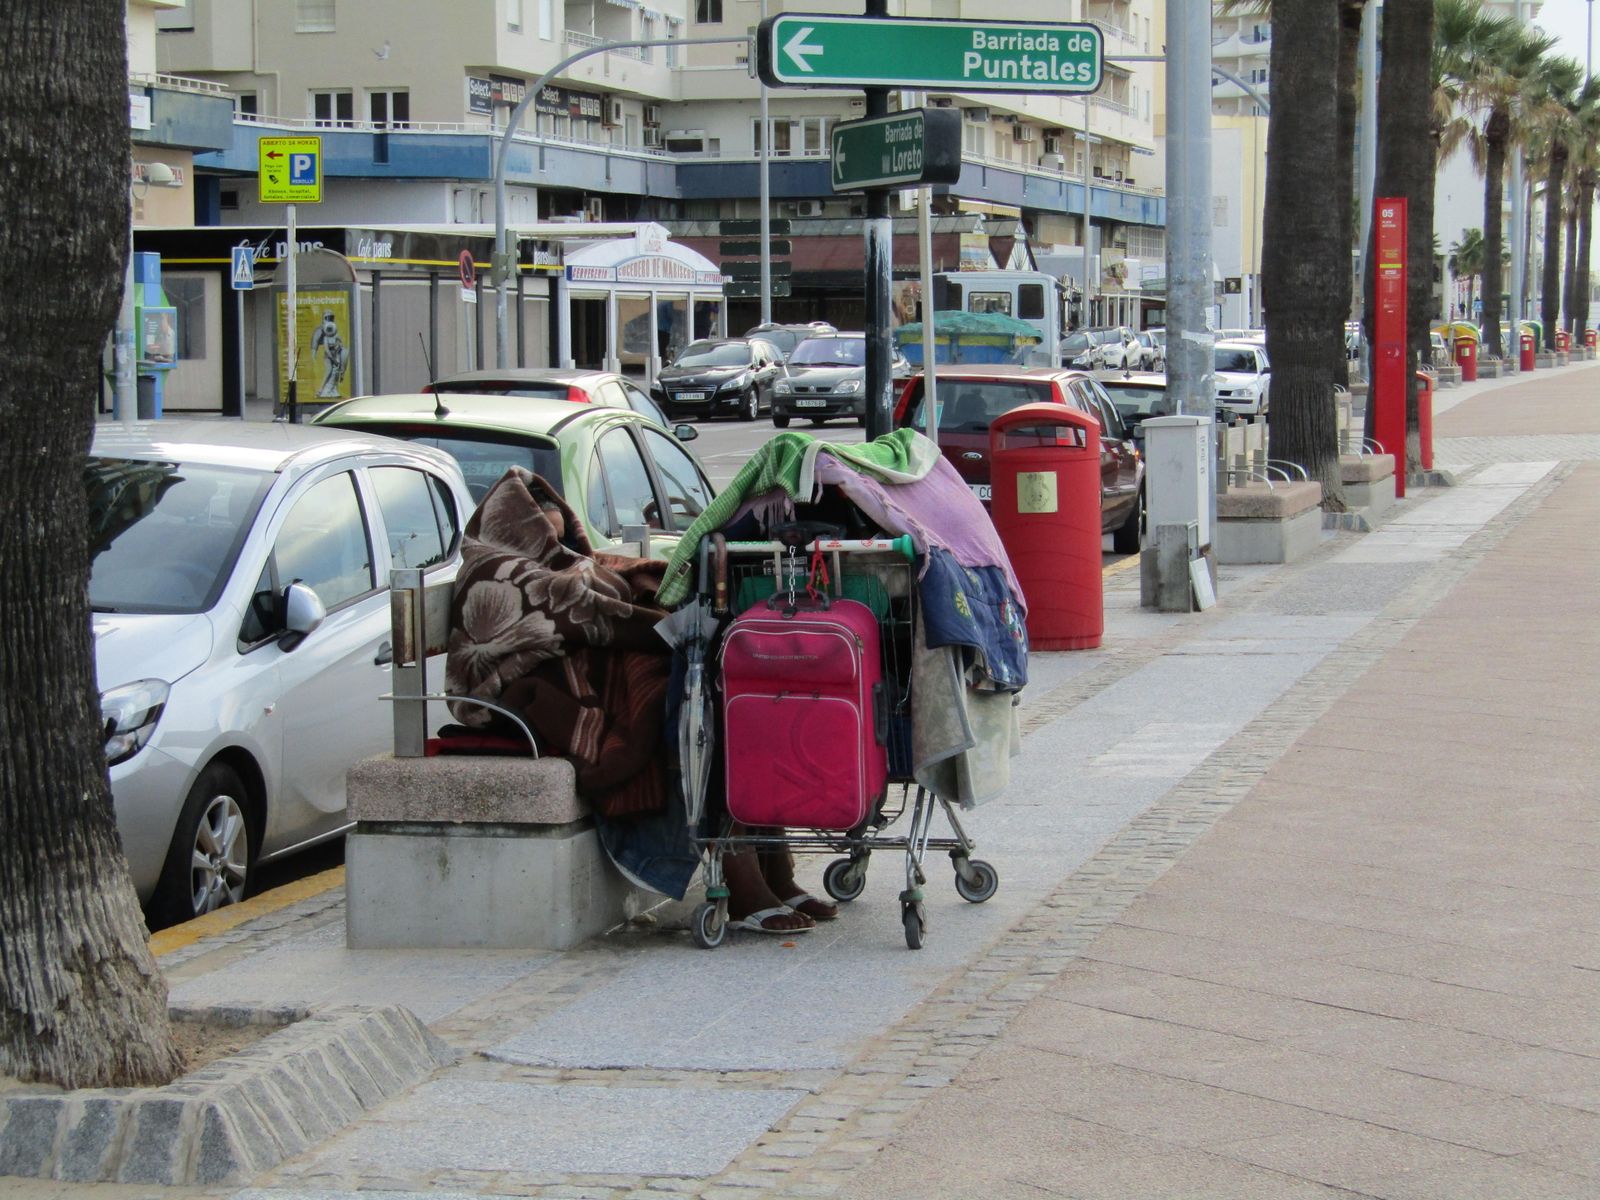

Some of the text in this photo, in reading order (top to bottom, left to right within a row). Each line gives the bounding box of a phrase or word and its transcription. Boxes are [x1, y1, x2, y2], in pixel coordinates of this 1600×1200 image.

[972, 31, 1093, 53] Barriada de
[963, 51, 1092, 82] Puntales
[885, 120, 923, 143] Barriada de
[294, 154, 312, 178] P
[892, 143, 922, 173] Loreto
